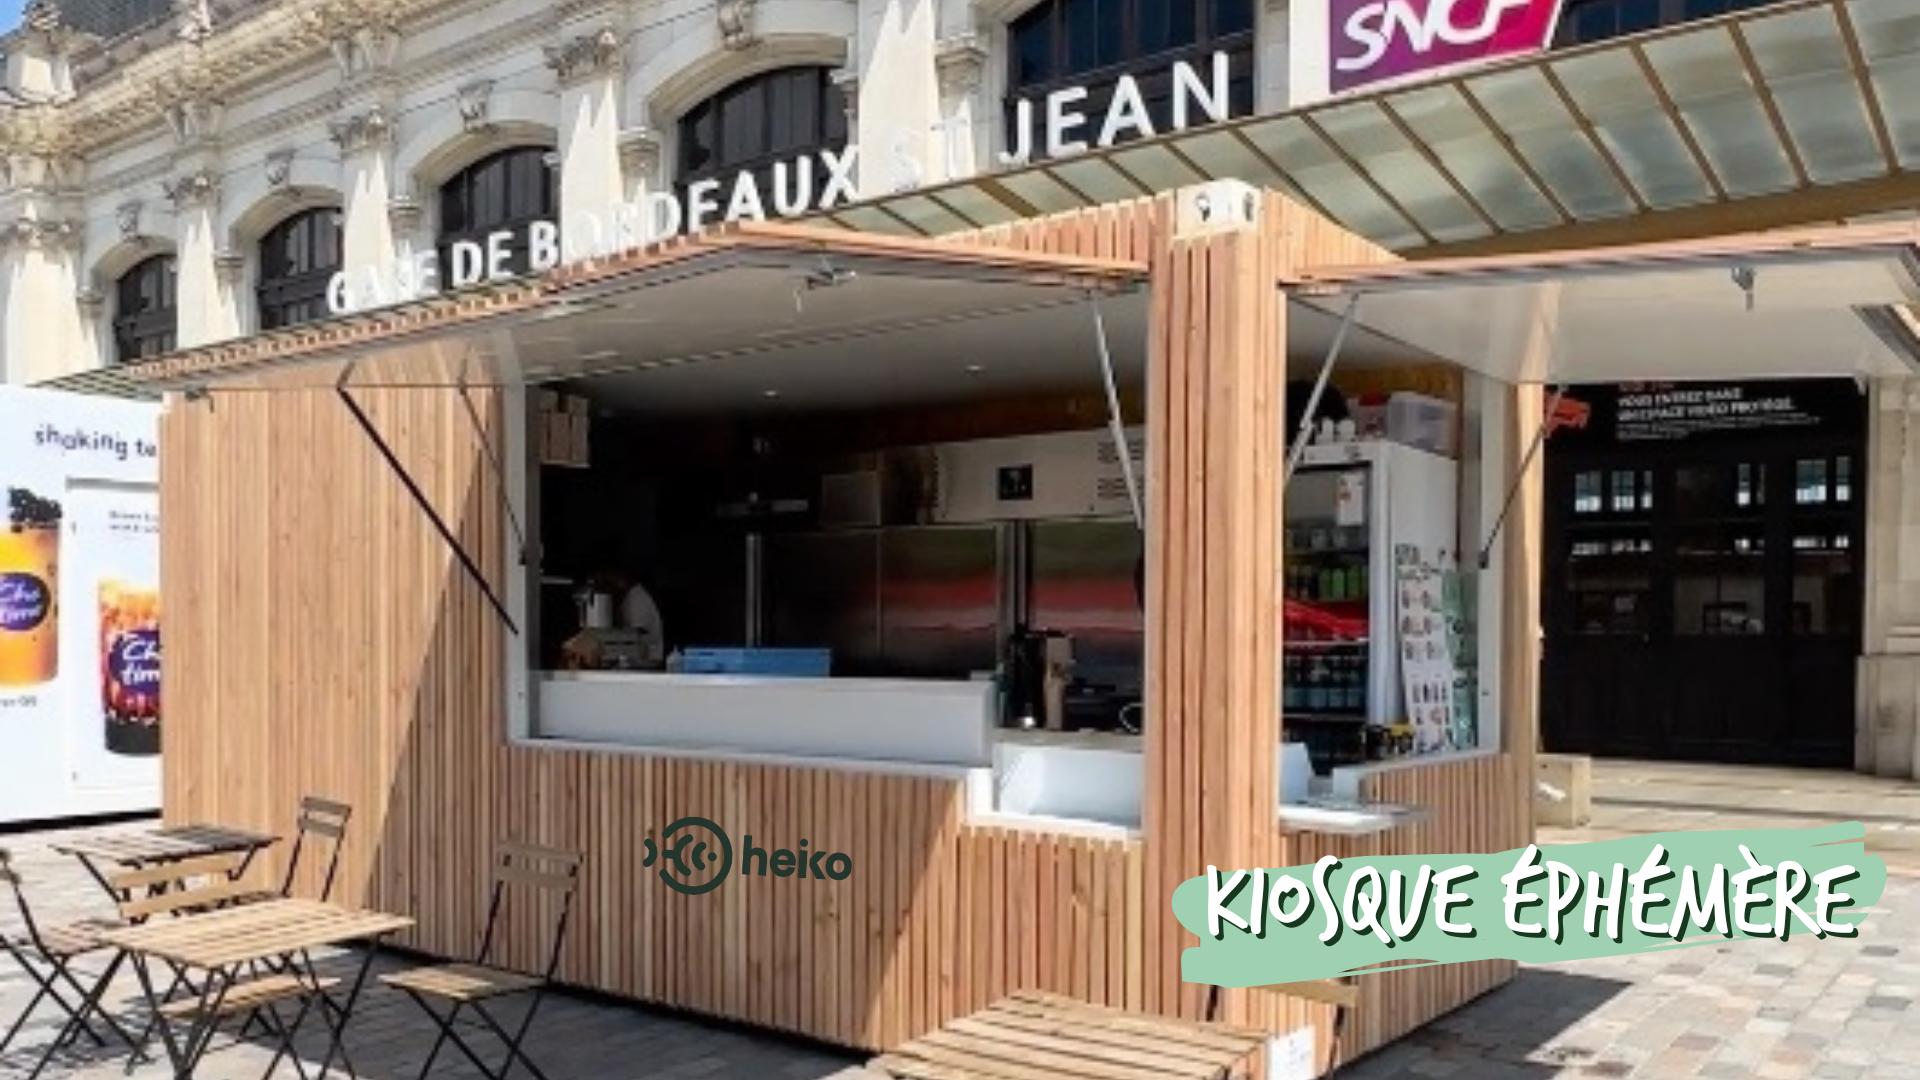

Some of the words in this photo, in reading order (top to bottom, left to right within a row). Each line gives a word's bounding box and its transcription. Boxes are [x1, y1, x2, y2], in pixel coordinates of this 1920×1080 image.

[452, 230, 516, 289] DE
[529, 145, 859, 271] BORDEAUX
[998, 50, 1230, 165] JEAN
[35, 423, 128, 461] shaking
